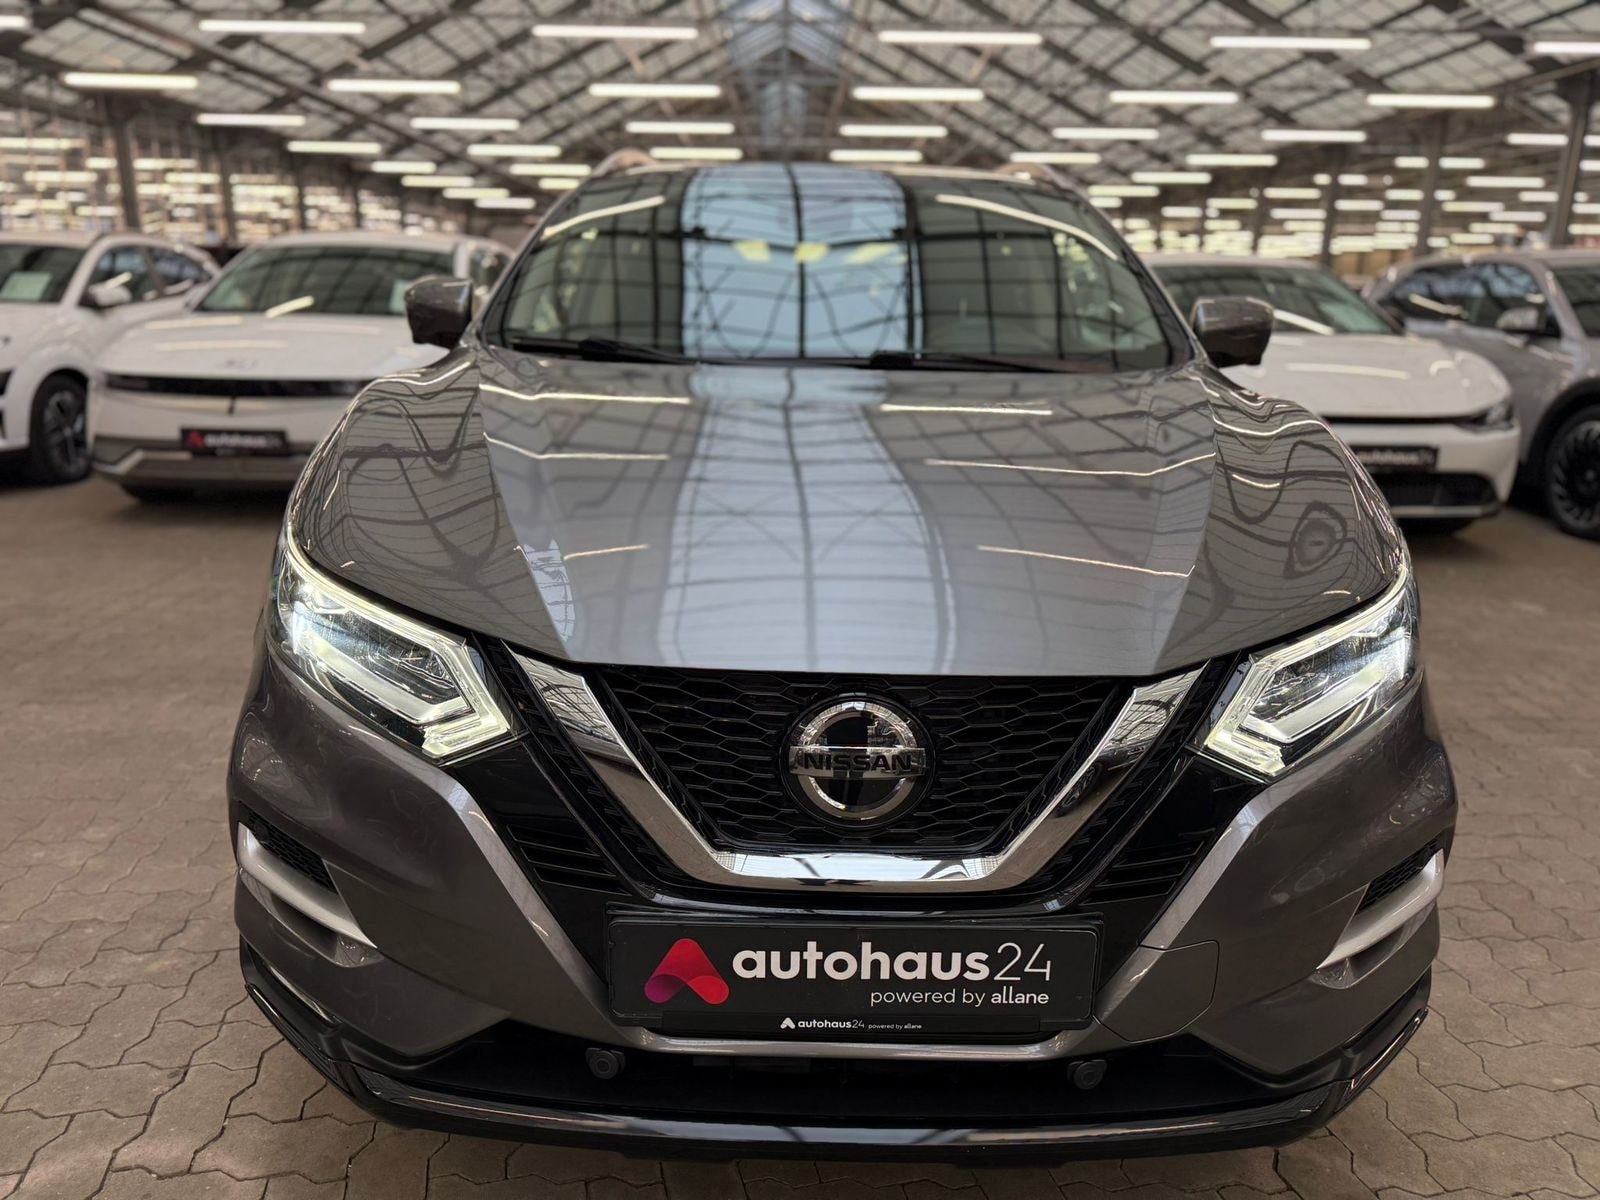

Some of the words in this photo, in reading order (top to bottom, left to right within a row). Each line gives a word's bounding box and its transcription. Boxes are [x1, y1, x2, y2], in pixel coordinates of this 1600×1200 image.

[803, 752, 912, 771] NISSAN
[732, 940, 1052, 981] autohaus24
[870, 988, 956, 1007] powered
[962, 988, 986, 1007] by
[991, 985, 1050, 1004] allane
[797, 1019, 865, 1029] autohaus24
